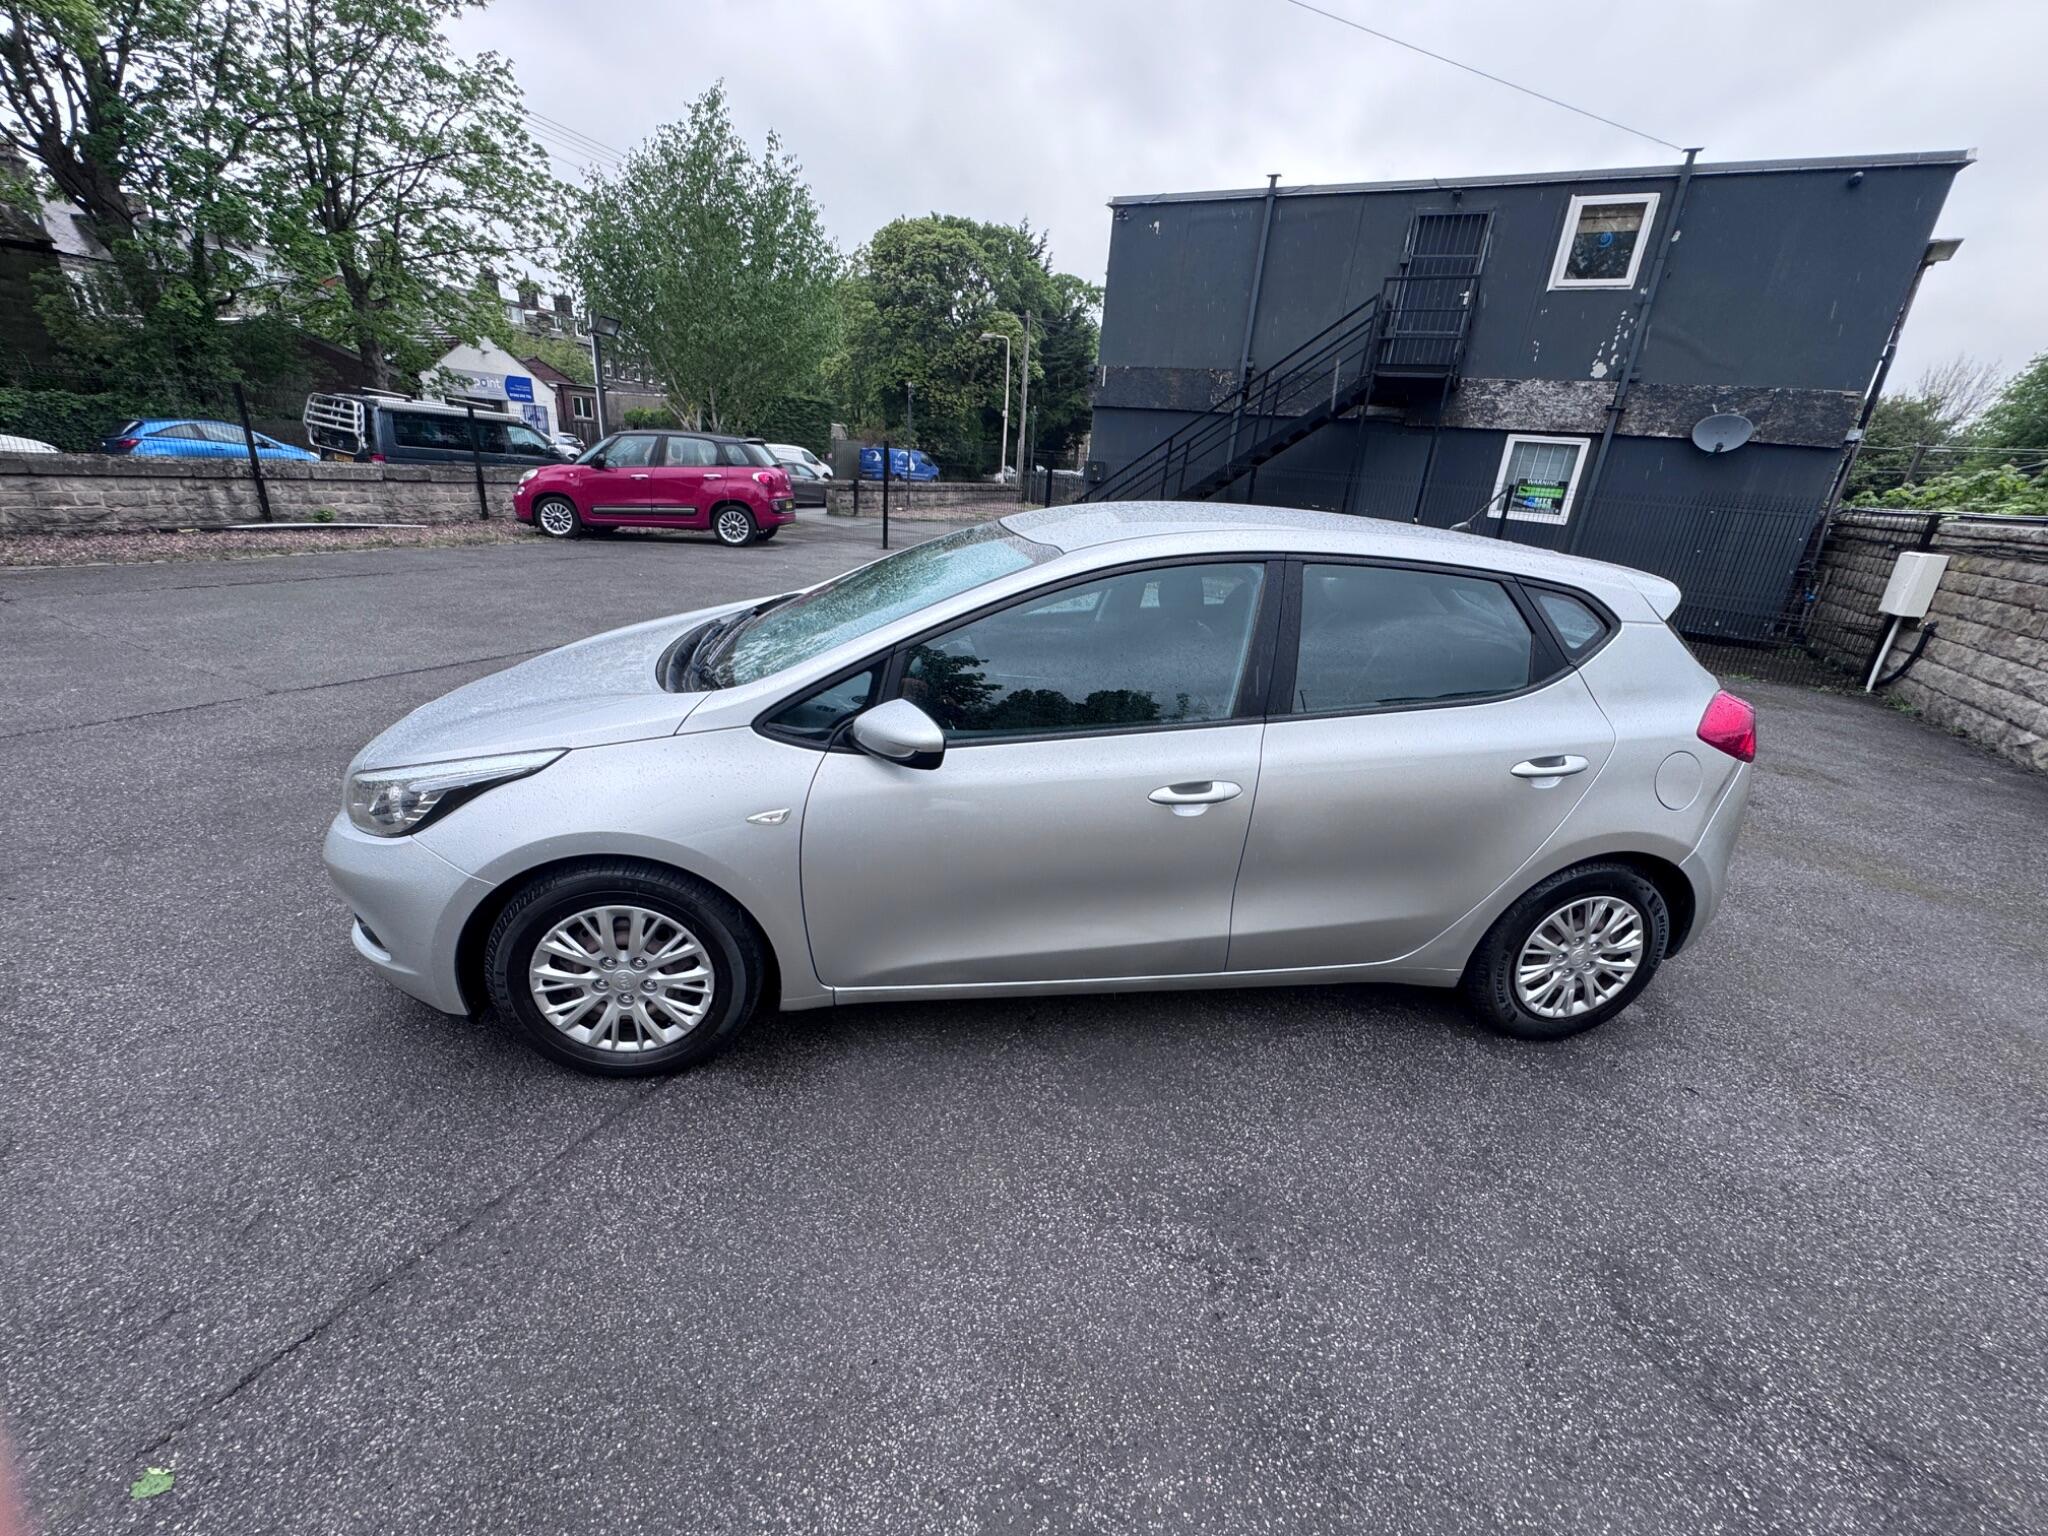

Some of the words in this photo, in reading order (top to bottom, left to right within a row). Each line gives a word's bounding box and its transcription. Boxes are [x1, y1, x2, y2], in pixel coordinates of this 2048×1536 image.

[1527, 479, 1559, 487] WARNING
[1652, 914, 1666, 967] MICHELIN
[1496, 951, 1510, 1003] MICHELIN
